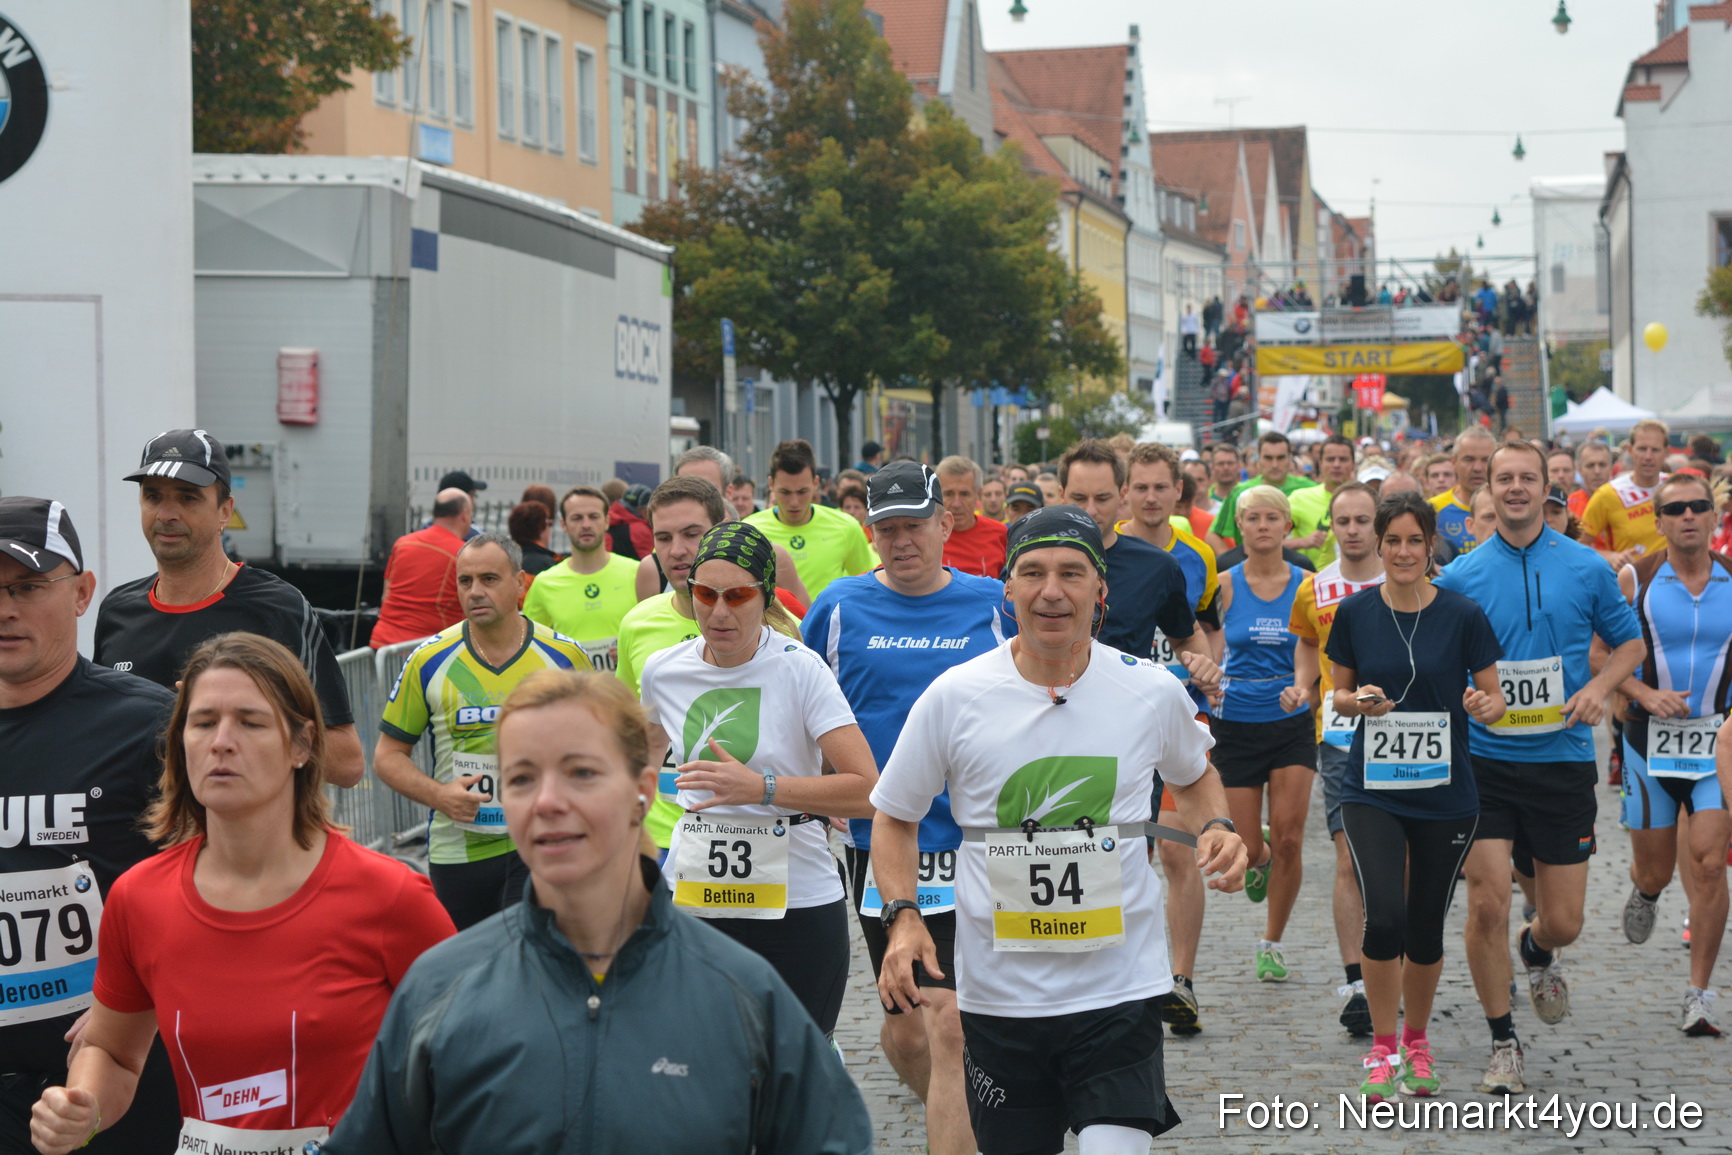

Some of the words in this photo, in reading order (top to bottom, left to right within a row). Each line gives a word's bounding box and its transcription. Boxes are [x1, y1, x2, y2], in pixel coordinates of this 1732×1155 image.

[614, 315, 661, 384] BOCK
[1324, 350, 1396, 368] START
[867, 636, 930, 649] Ski-Club
[932, 636, 970, 649] Lauf
[1501, 677, 1550, 707] 304
[456, 705, 502, 725] BO
[1366, 719, 1394, 728] PARTL
[1396, 720, 1436, 729] Neumarkt
[1509, 712, 1544, 725] Simon
[1373, 731, 1443, 760] 2475
[1656, 730, 1718, 755] 2127
[454, 759, 481, 771] PARTL
[1392, 766, 1421, 779] Julia
[1674, 760, 1699, 771] Hans
[36, 831, 80, 841] SWEDEN
[683, 823, 713, 834] PARTL
[716, 824, 769, 836] Neumarkt
[988, 845, 1032, 857] PARTL
[1035, 842, 1097, 857] Neumarkt
[708, 839, 753, 879] 53
[1029, 861, 1085, 907] 54
[703, 888, 756, 904] Bettina
[0, 902, 93, 967] 079
[1029, 918, 1088, 936] Rainer
[222, 1086, 260, 1109] DEHN
[181, 1134, 210, 1155] PARTL
